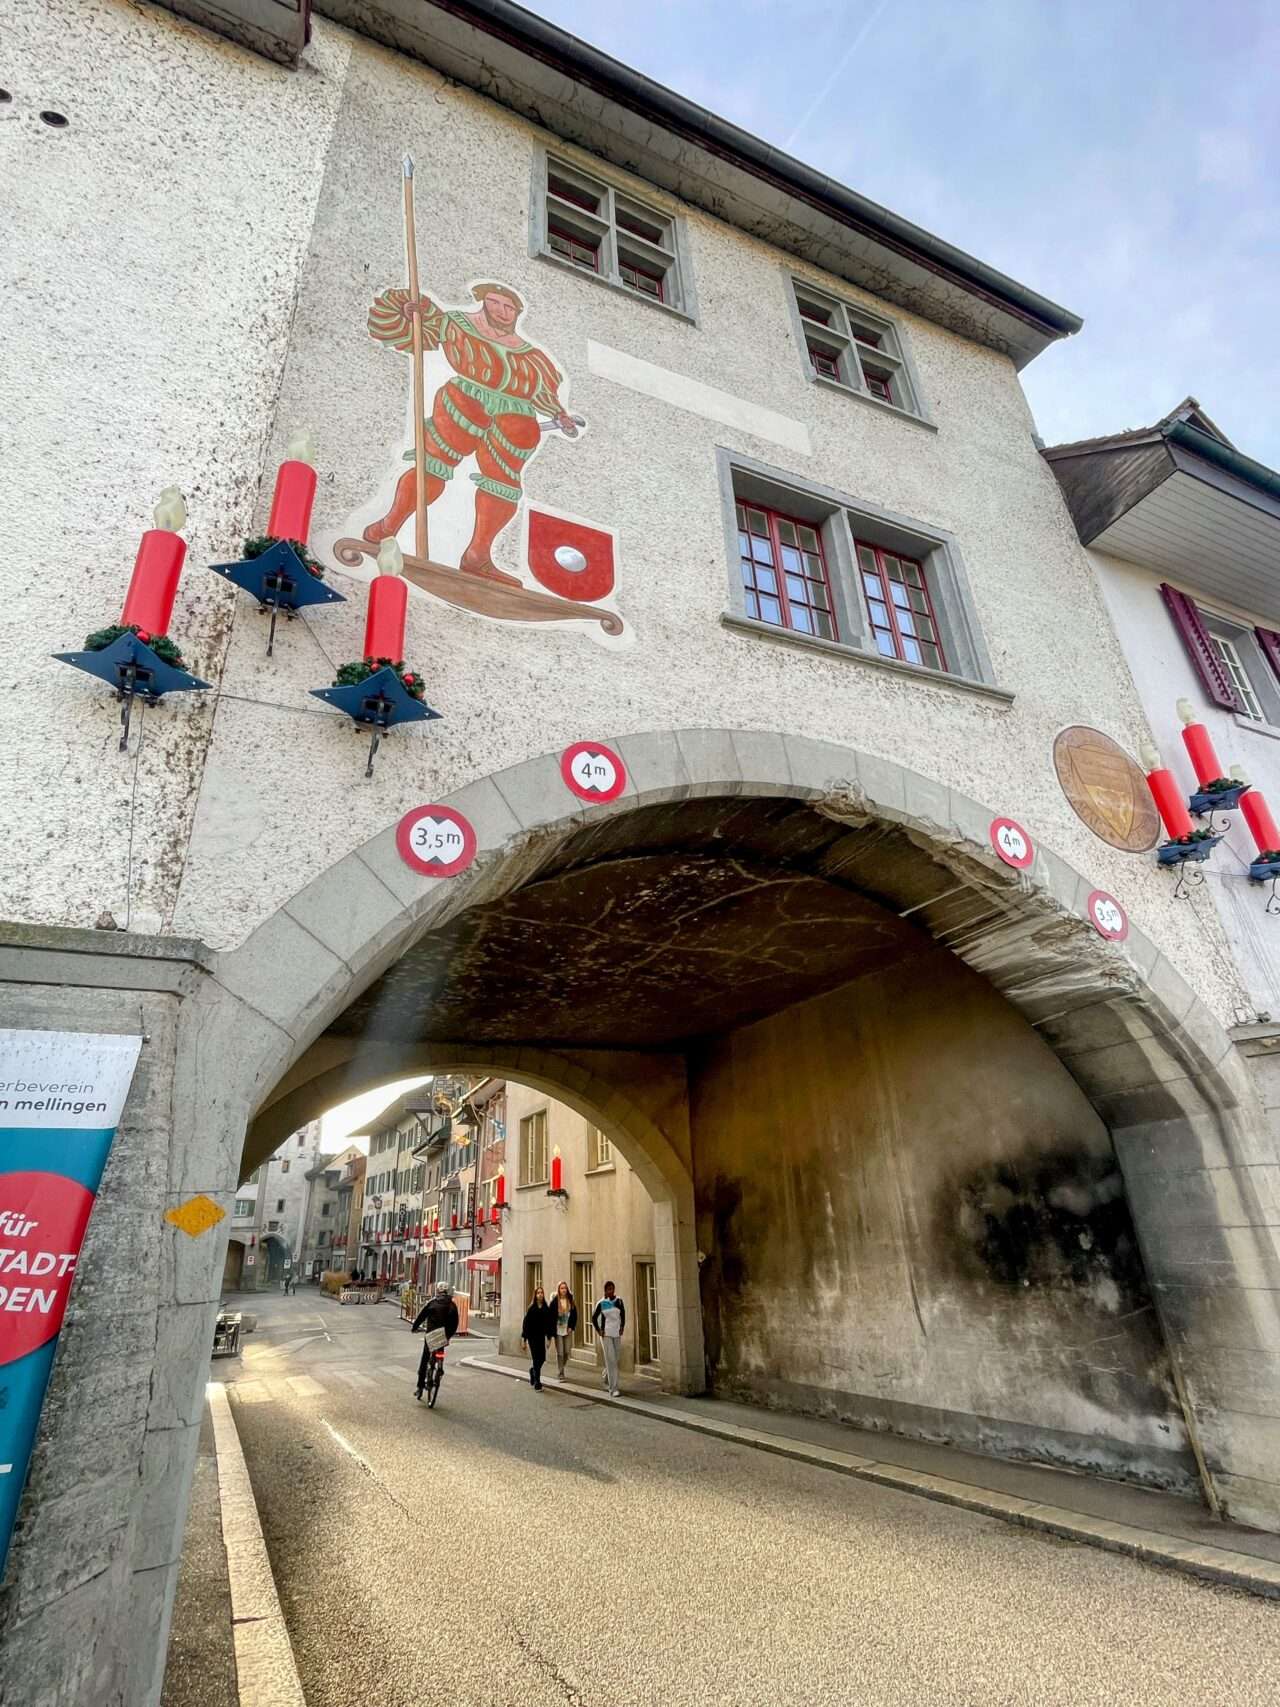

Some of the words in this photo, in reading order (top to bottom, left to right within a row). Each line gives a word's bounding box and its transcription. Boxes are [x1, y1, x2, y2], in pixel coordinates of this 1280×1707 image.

[580, 762, 606, 779] 4m
[415, 826, 461, 850] 3,5m
[1003, 833, 1021, 848] 4m
[14, 1098, 107, 1115] mellingen
[0, 1210, 39, 1237] für
